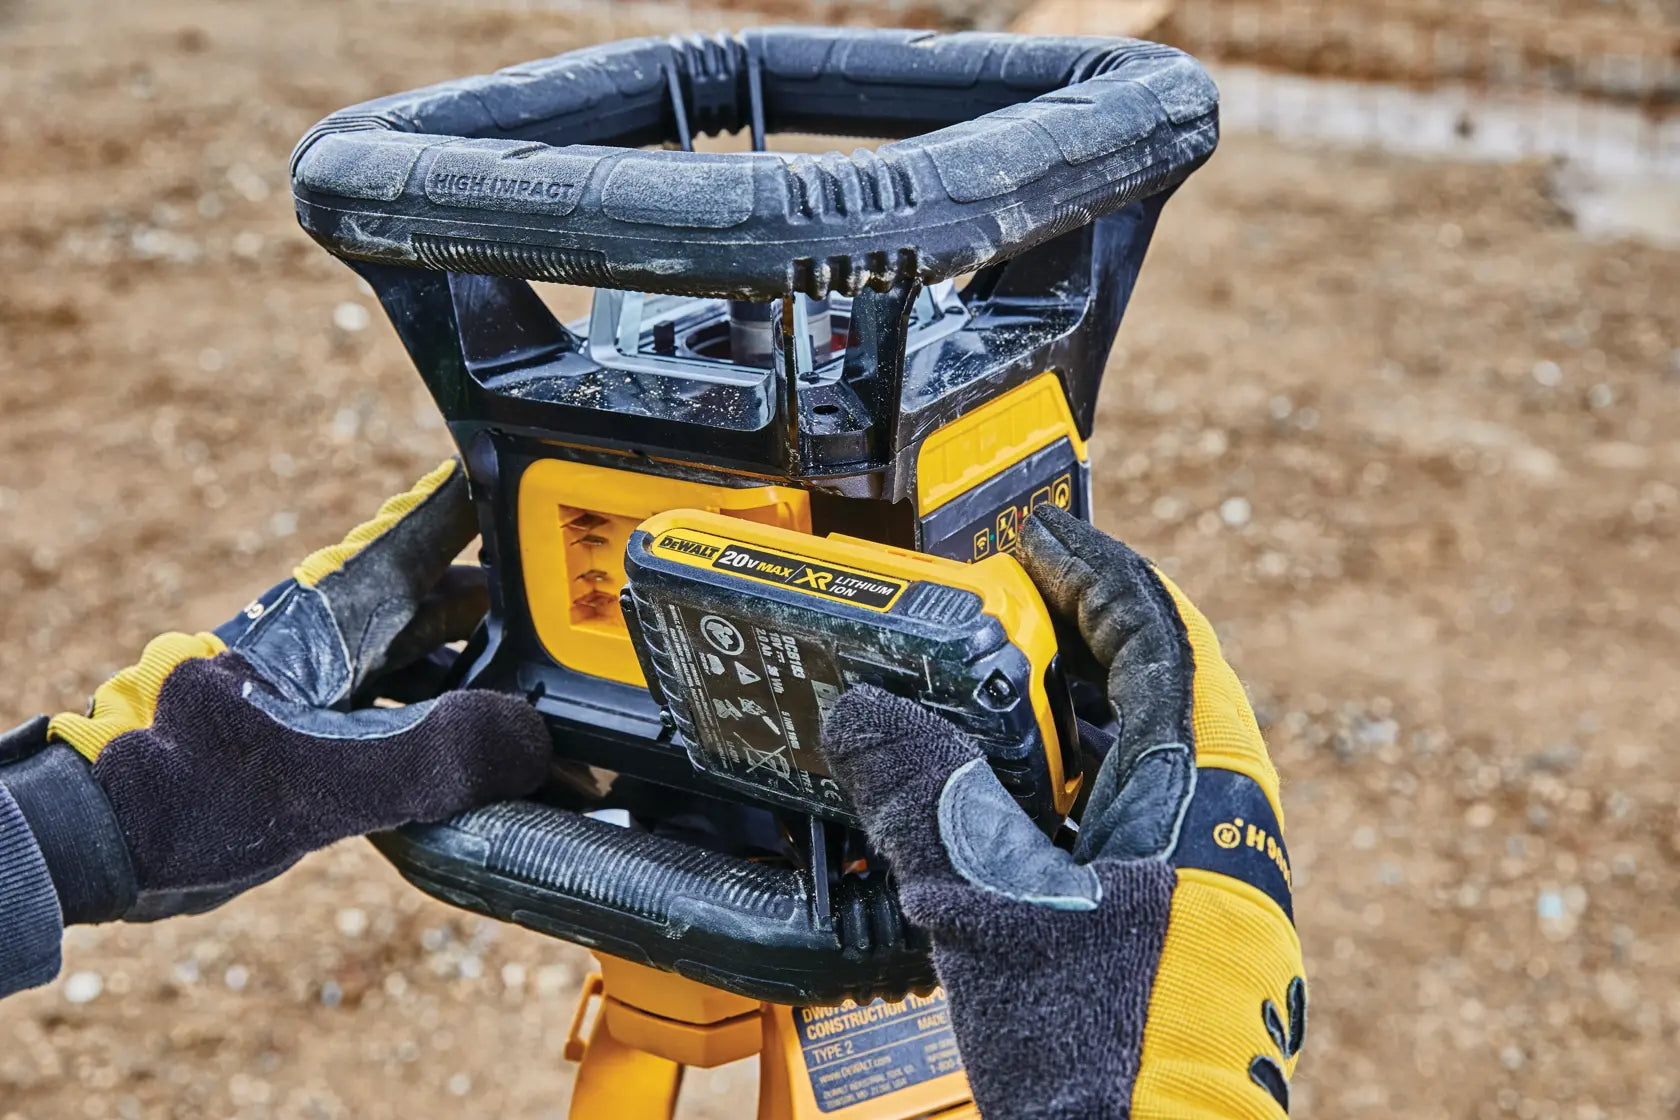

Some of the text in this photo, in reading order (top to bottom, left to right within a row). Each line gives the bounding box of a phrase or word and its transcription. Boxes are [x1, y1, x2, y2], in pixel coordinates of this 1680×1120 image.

[435, 172, 575, 201] HIGH IMPACT
[657, 535, 722, 560] DEWALT
[757, 561, 795, 579] MAX
[793, 566, 834, 592] XR
[829, 583, 856, 598] ION
[835, 575, 895, 597] LITHIUM
[805, 1000, 908, 1041] CONSTRUCTION
[812, 1040, 855, 1064] TYPE 2
